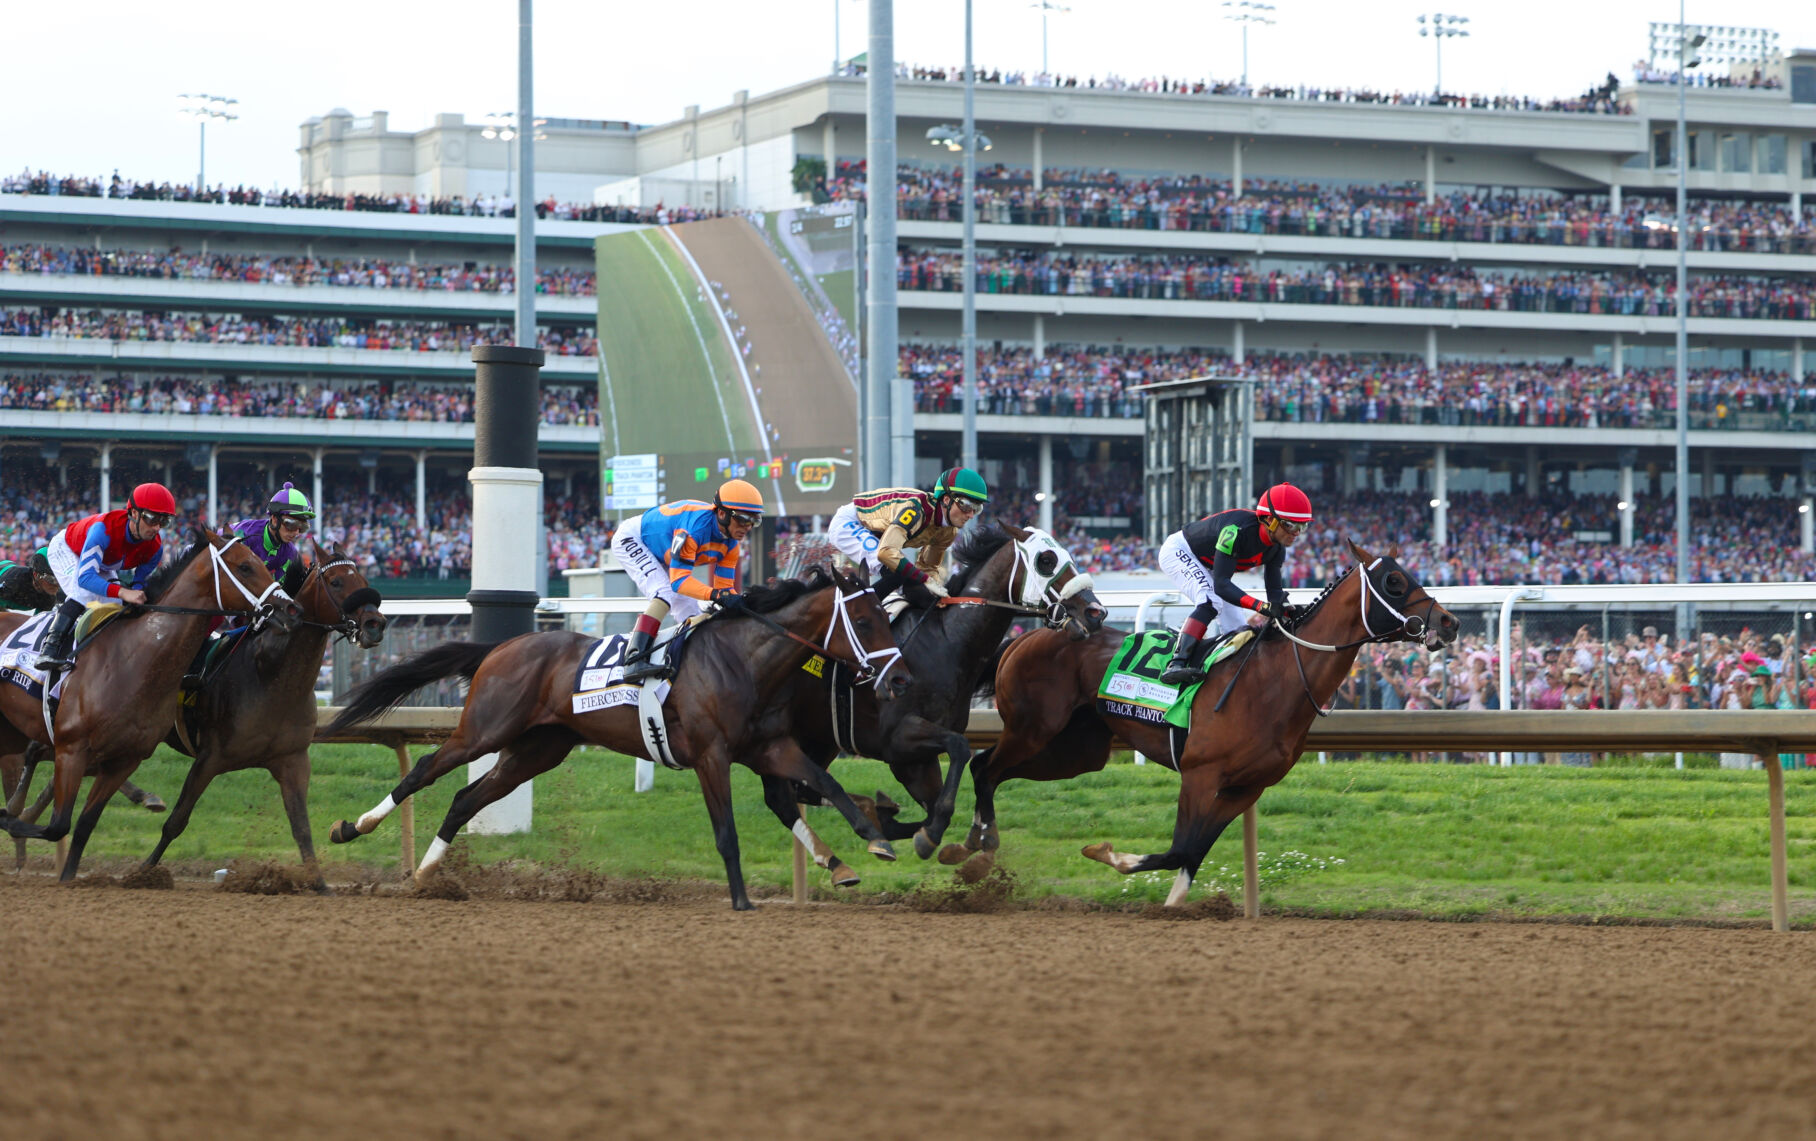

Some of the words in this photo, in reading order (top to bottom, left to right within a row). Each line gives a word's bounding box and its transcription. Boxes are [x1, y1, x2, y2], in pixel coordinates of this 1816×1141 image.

[899, 509, 917, 526] 6
[1218, 528, 1235, 549] 12
[1175, 549, 1211, 590] SENTIENT
[1180, 568, 1194, 581] JET
[1117, 632, 1176, 680] 12
[1105, 700, 1134, 717] TRACK
[1134, 705, 1167, 724] PHANTO
